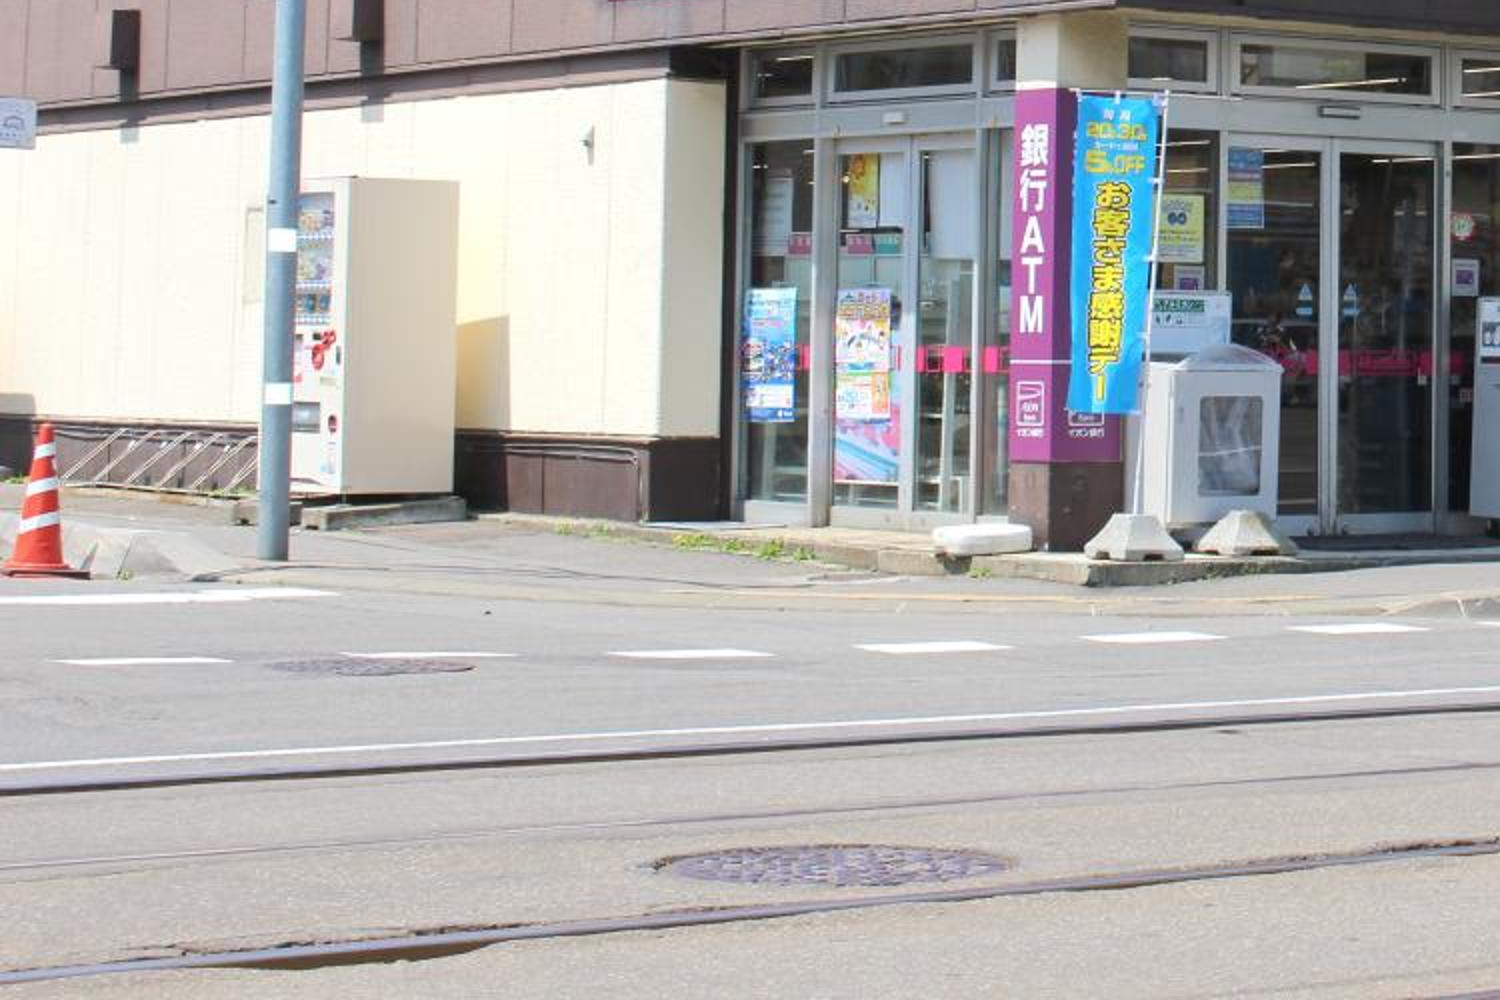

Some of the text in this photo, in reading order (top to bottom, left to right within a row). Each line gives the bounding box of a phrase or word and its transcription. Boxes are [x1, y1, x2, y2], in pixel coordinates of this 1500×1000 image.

[1087, 180, 1133, 401] お客さま感謝デー
